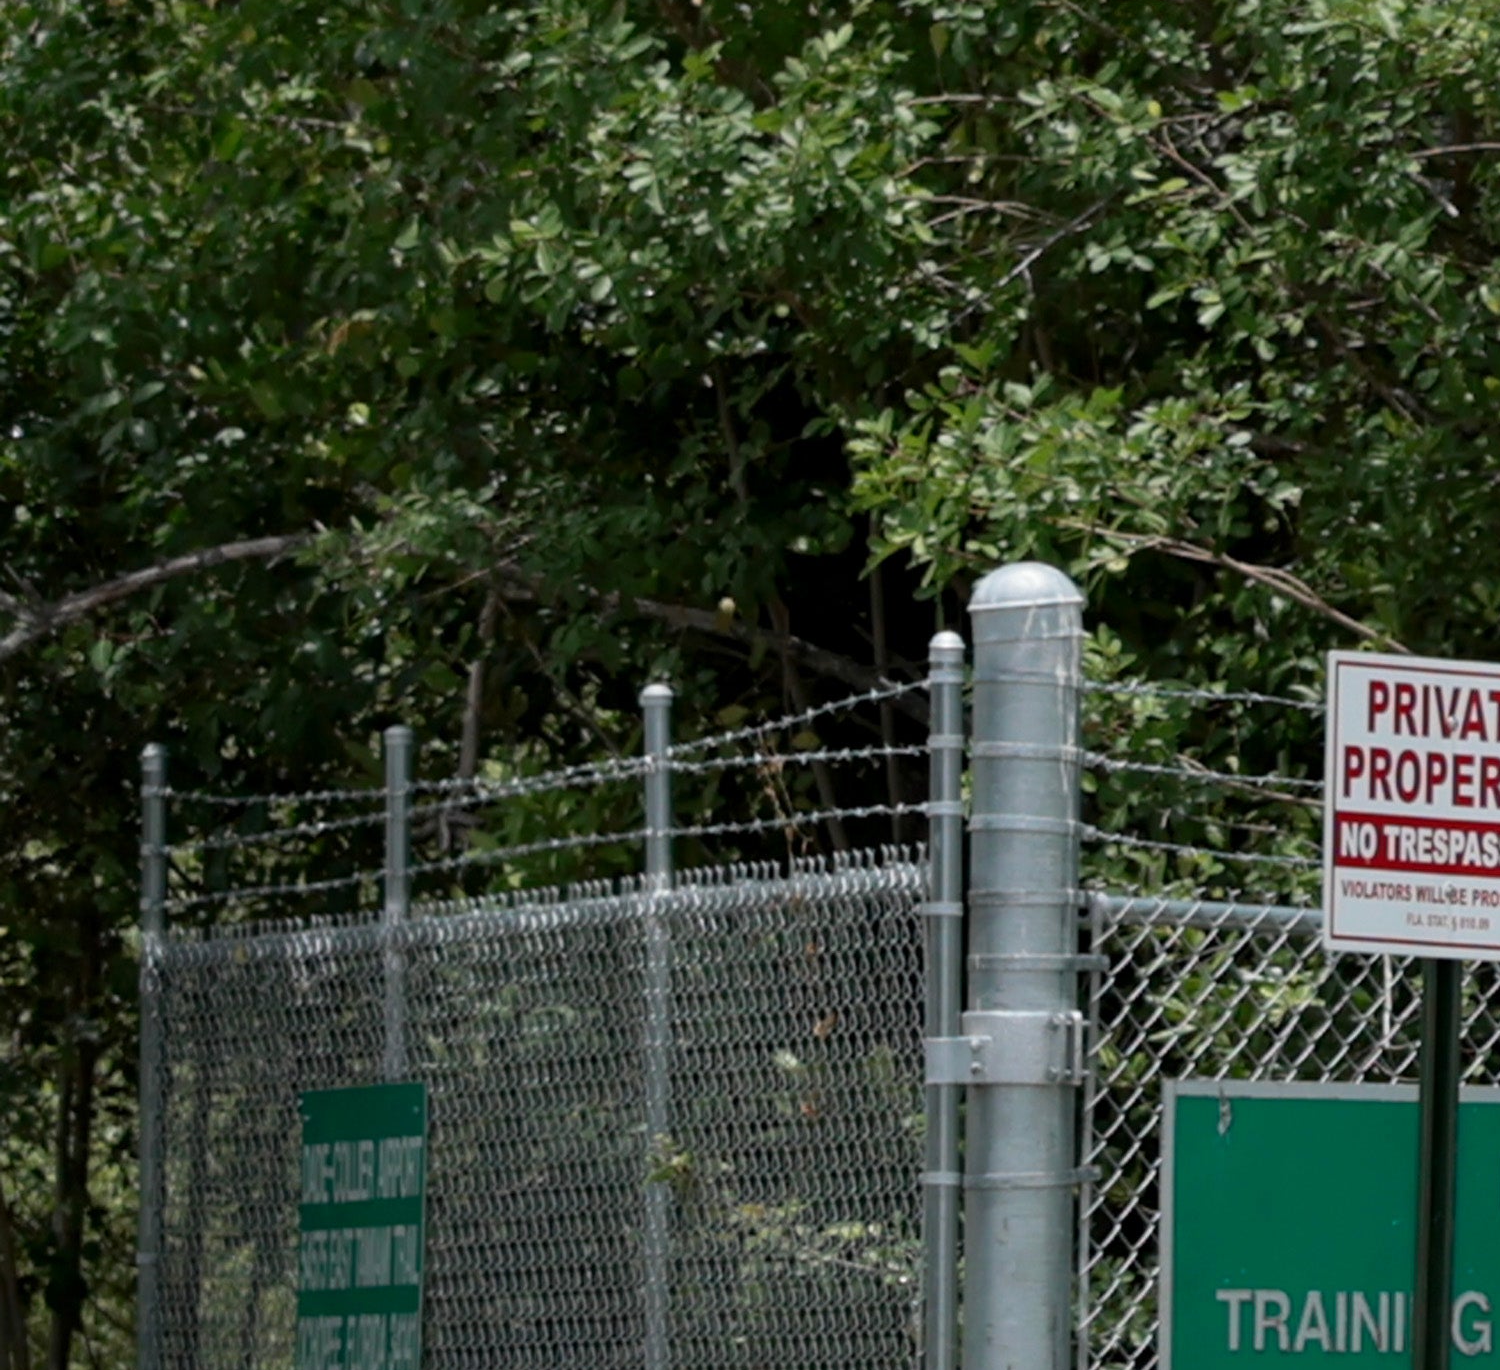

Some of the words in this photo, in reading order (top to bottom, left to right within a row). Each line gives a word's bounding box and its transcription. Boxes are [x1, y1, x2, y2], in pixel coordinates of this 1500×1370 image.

[1340, 822, 1378, 859] NO
[1341, 880, 1412, 902] VIOLATORS
[1416, 884, 1446, 905] WILL
[1449, 887, 1467, 905] BE
[1215, 1288, 1492, 1356] TRAINIG
